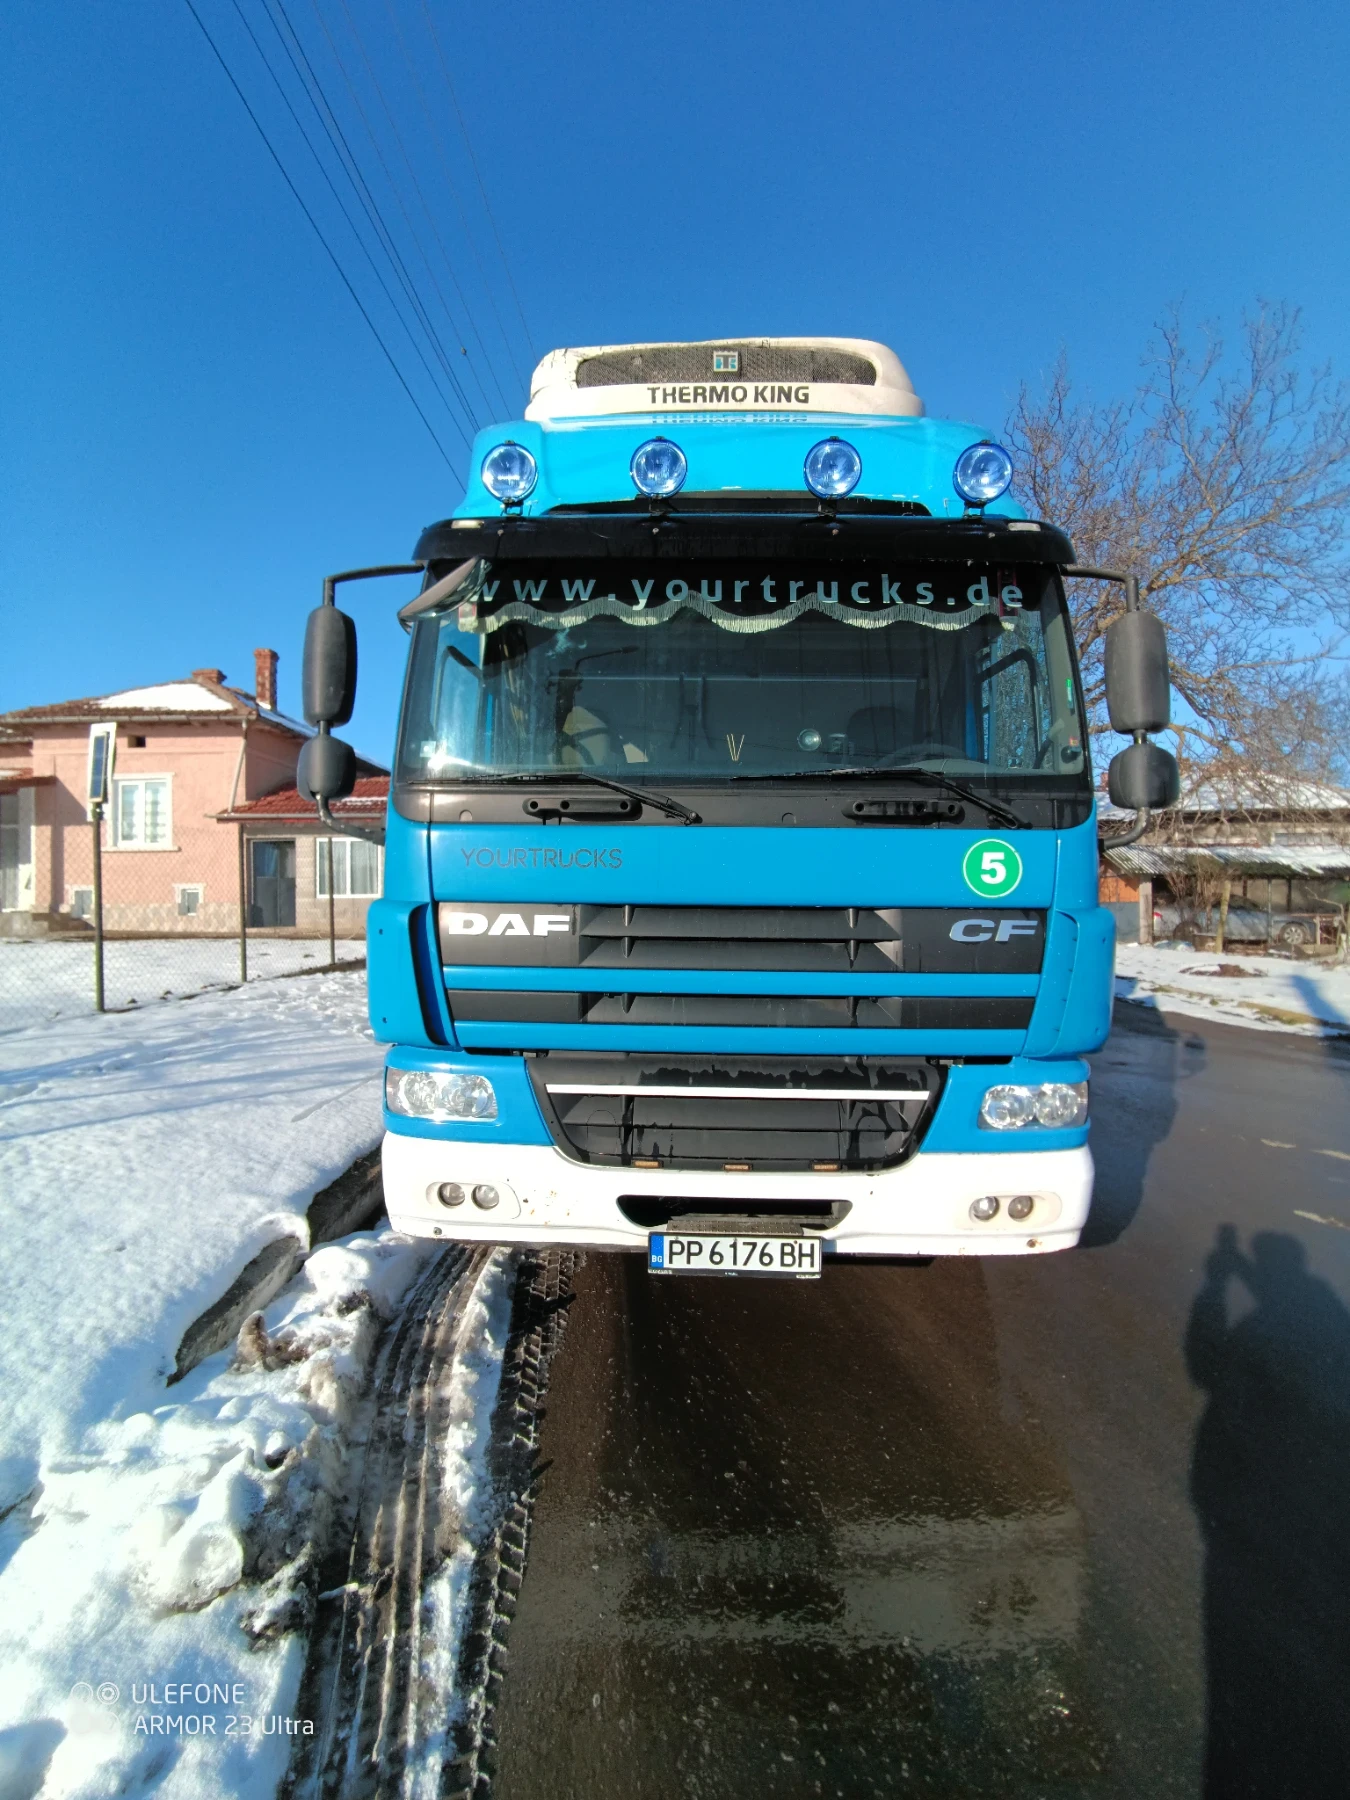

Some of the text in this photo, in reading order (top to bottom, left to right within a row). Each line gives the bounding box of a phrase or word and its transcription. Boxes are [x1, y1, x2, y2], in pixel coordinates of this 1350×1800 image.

[647, 386, 810, 404] THERMO KING
[460, 847, 623, 869] YOURTRUCKS
[980, 851, 1006, 884] 5
[448, 911, 570, 936] DAF
[949, 918, 1038, 942] CF
[651, 1239, 815, 1268] BG PP 6176 BH
